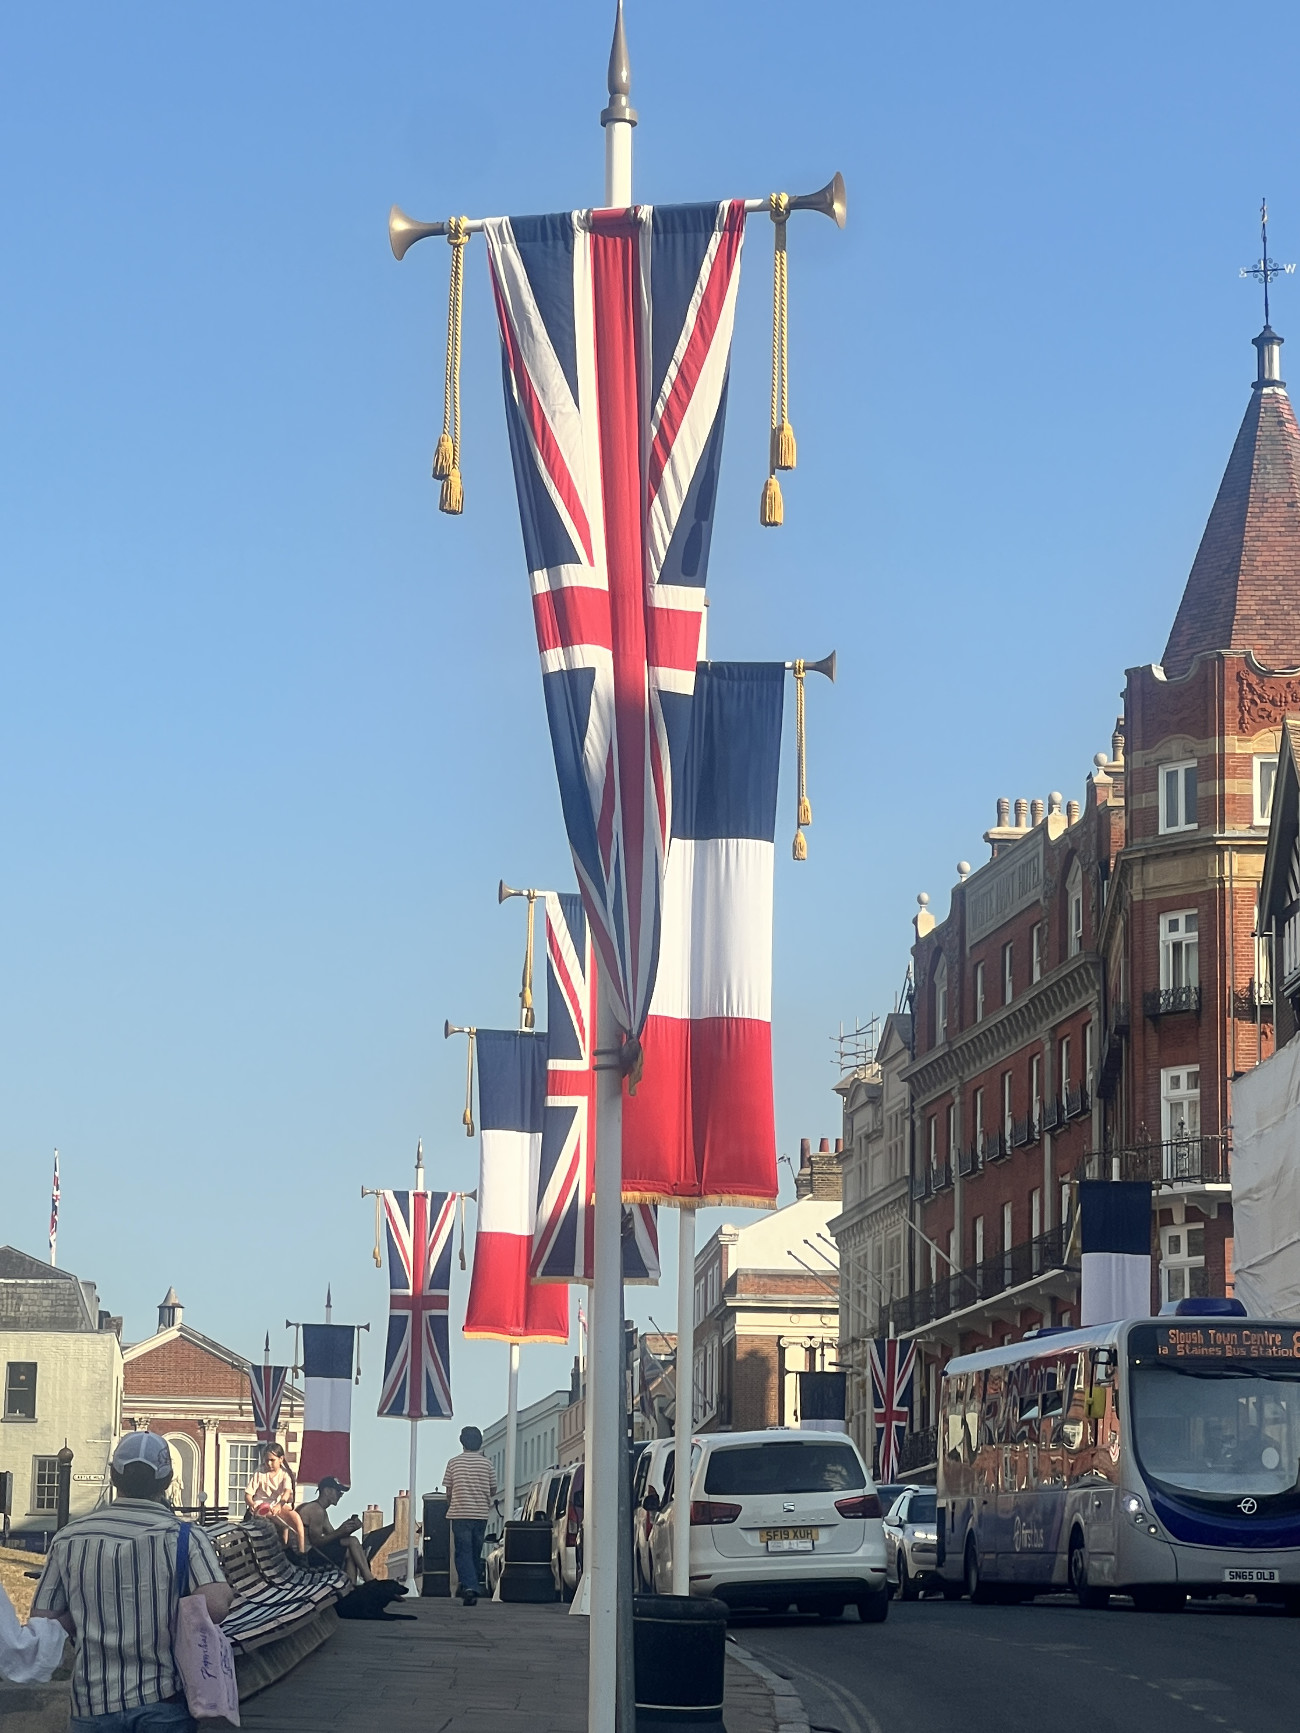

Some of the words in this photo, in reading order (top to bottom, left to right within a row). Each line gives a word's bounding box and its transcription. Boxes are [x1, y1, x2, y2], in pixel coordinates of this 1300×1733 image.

[1018, 852, 1040, 900] HOTEL
[1168, 1329, 1204, 1344] Slough
[1208, 1329, 1238, 1345] Town
[1242, 1330, 1281, 1346] Centre
[1176, 1344, 1221, 1356] Staines
[1225, 1345, 1246, 1357] Bus
[766, 1530, 789, 1541] SF19
[792, 1529, 813, 1540] XUH
[1229, 1571, 1253, 1580] SN65
[1256, 1571, 1274, 1580] OLB
